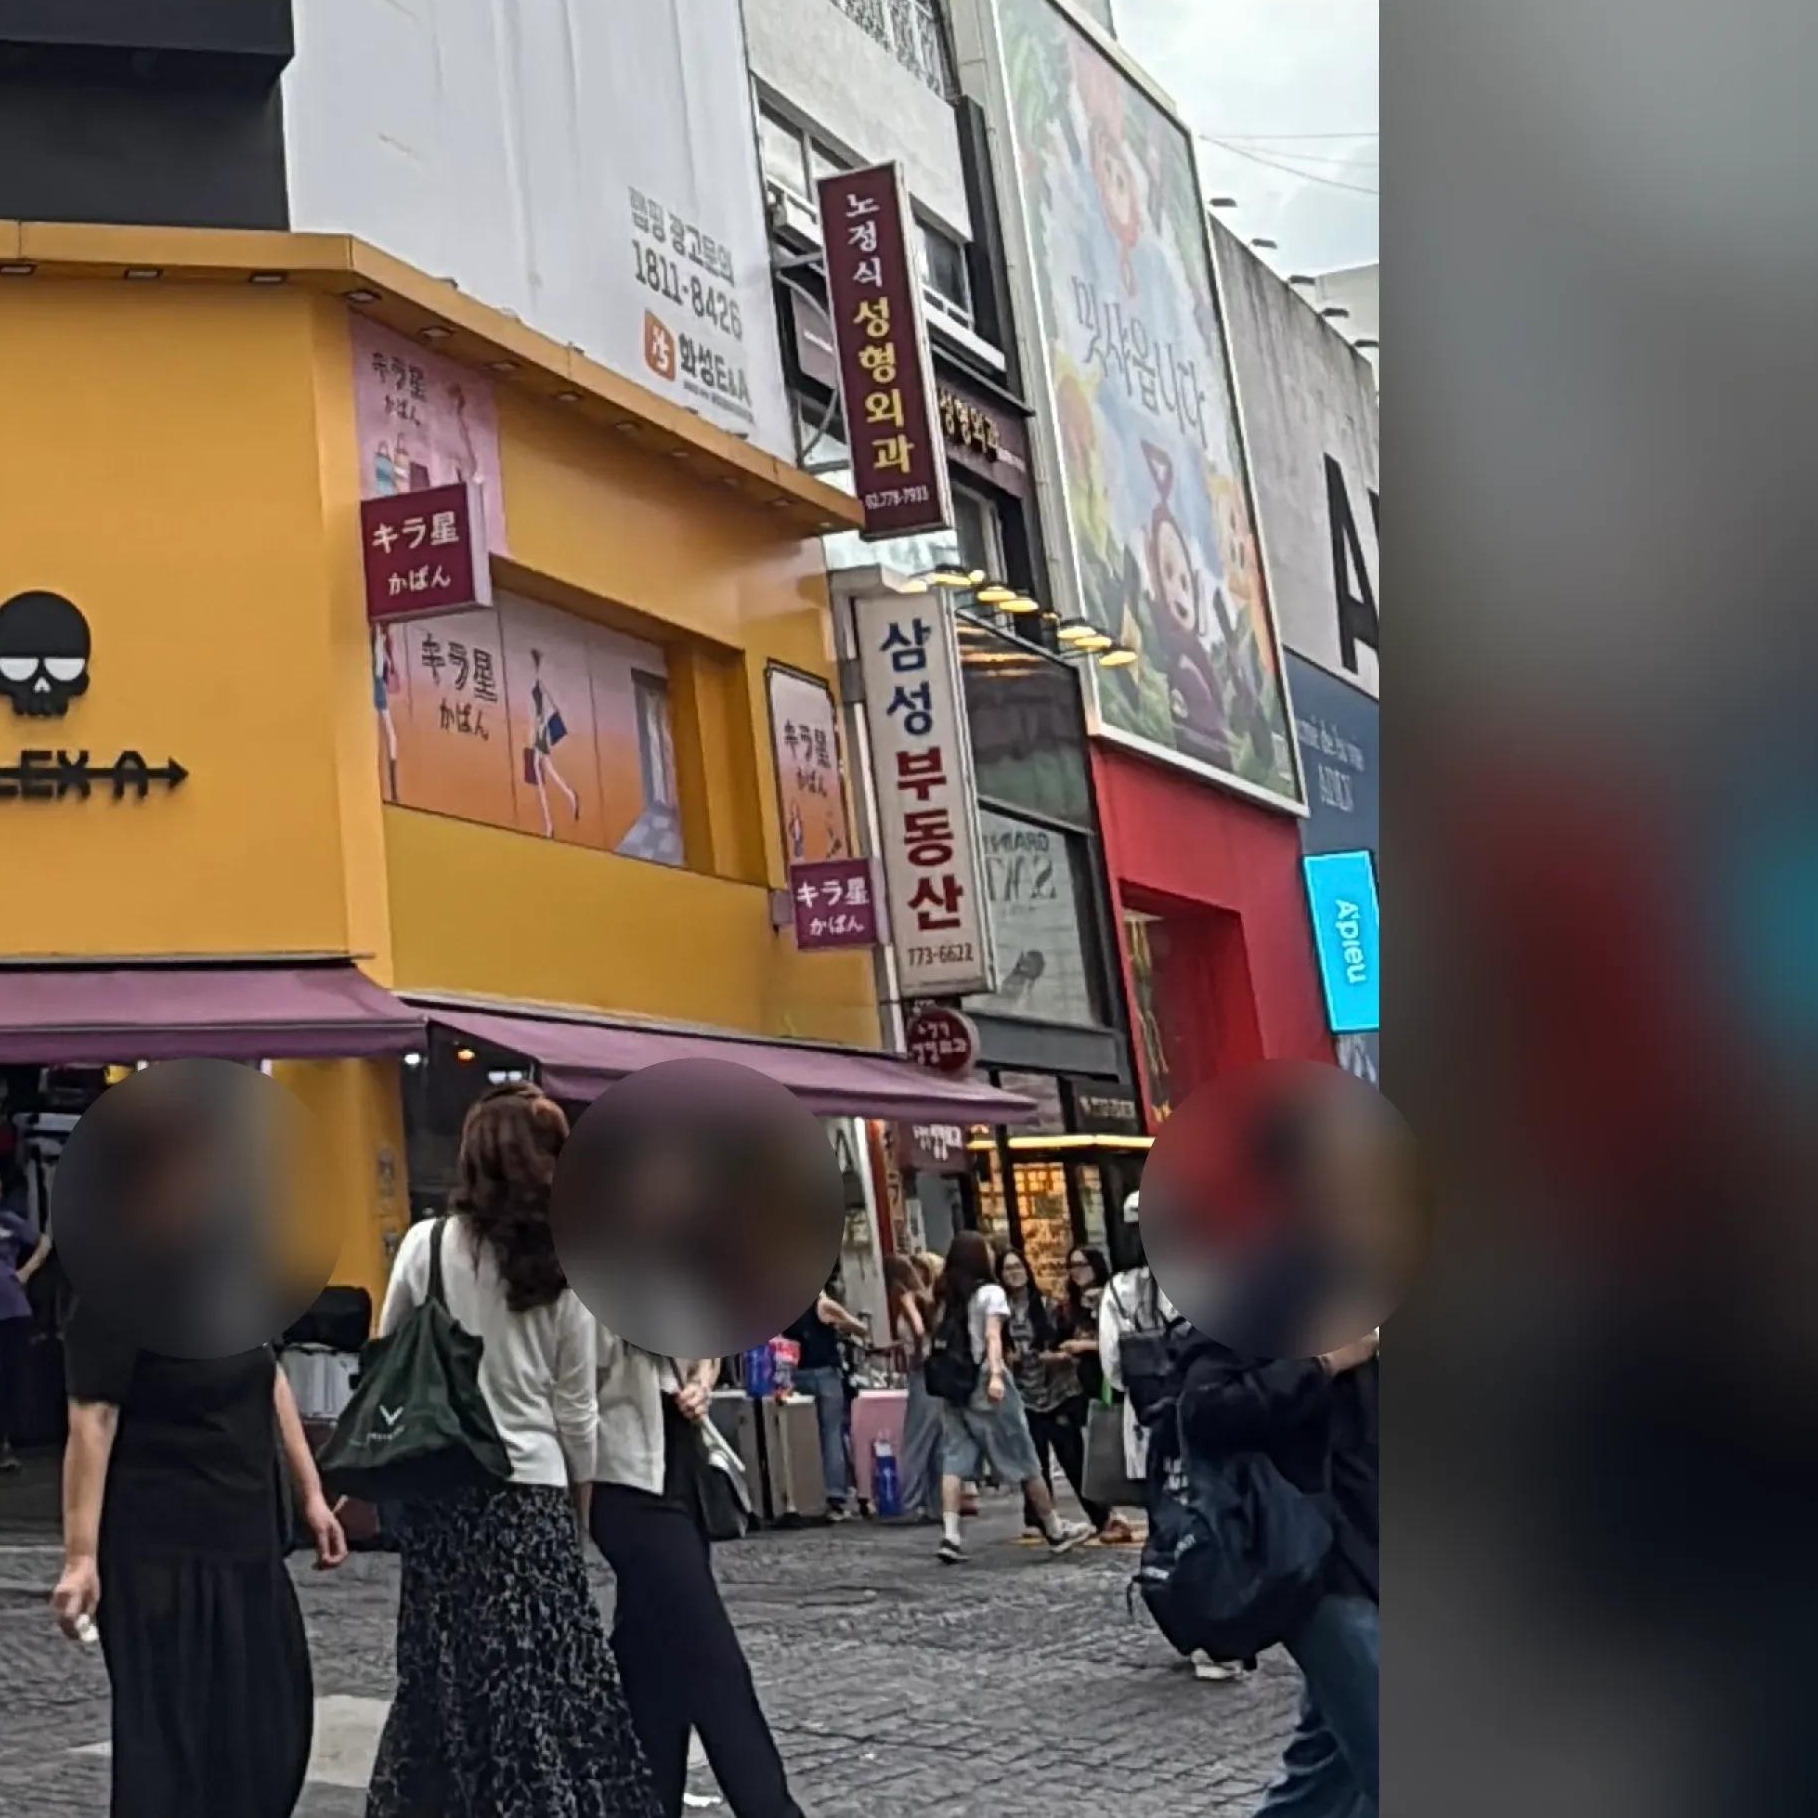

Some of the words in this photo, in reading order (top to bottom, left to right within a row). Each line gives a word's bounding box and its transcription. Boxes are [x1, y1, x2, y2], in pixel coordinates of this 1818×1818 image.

[844, 192, 883, 288] 노정식
[852, 295, 916, 475] 성형외과
[371, 510, 461, 556] キラ星
[386, 566, 452, 597] かばん
[1323, 452, 1380, 675] A
[419, 632, 499, 705] キラ星
[438, 698, 490, 741] かばん
[795, 877, 871, 910] キラ星
[808, 916, 866, 937] かばん
